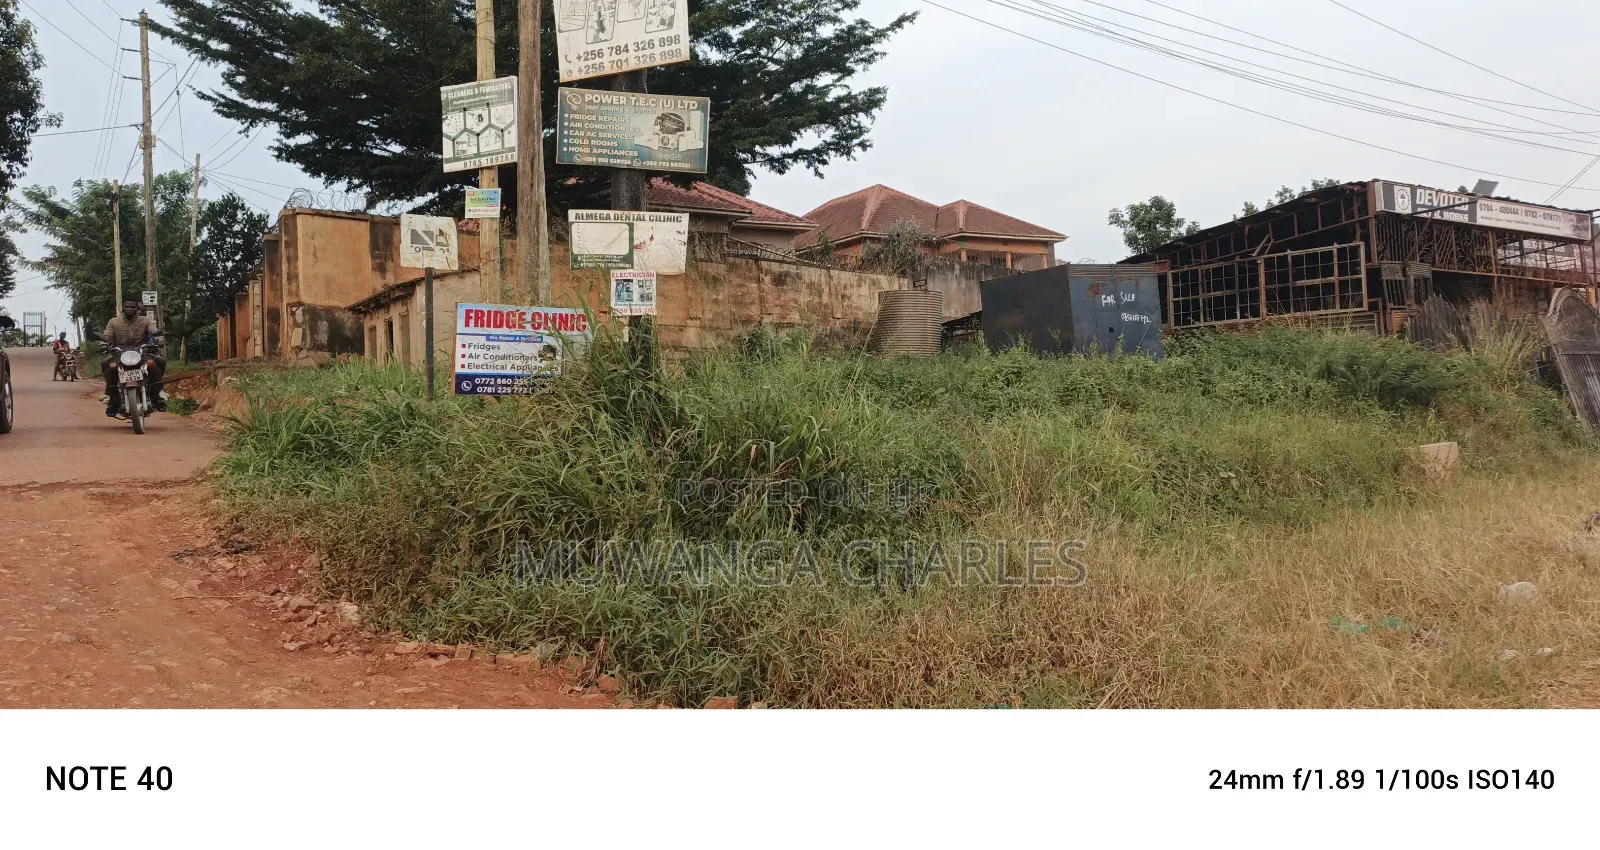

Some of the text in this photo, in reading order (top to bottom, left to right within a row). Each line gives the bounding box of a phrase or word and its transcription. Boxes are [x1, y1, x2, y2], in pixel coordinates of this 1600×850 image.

[576, 34, 681, 62] +256 784 326 898
[577, 48, 682, 76] +256 701 326 898
[448, 88, 474, 99] CLEANERS
[480, 82, 512, 94] FUMIGATORS
[584, 94, 698, 110] POWER T.E.C (U) LTD
[599, 115, 630, 123] REPAIRS
[584, 122, 640, 132] CONDITIONERS
[592, 148, 638, 157] APPLIANCES
[1416, 188, 1469, 211] DEVOTED
[575, 212, 611, 221] ALMEGA
[614, 213, 646, 222] DENTAL
[1444, 210, 1468, 222] WORKS
[1102, 292, 1136, 306] FOR SALE
[464, 309, 587, 332] FRIDGE CLINIC
